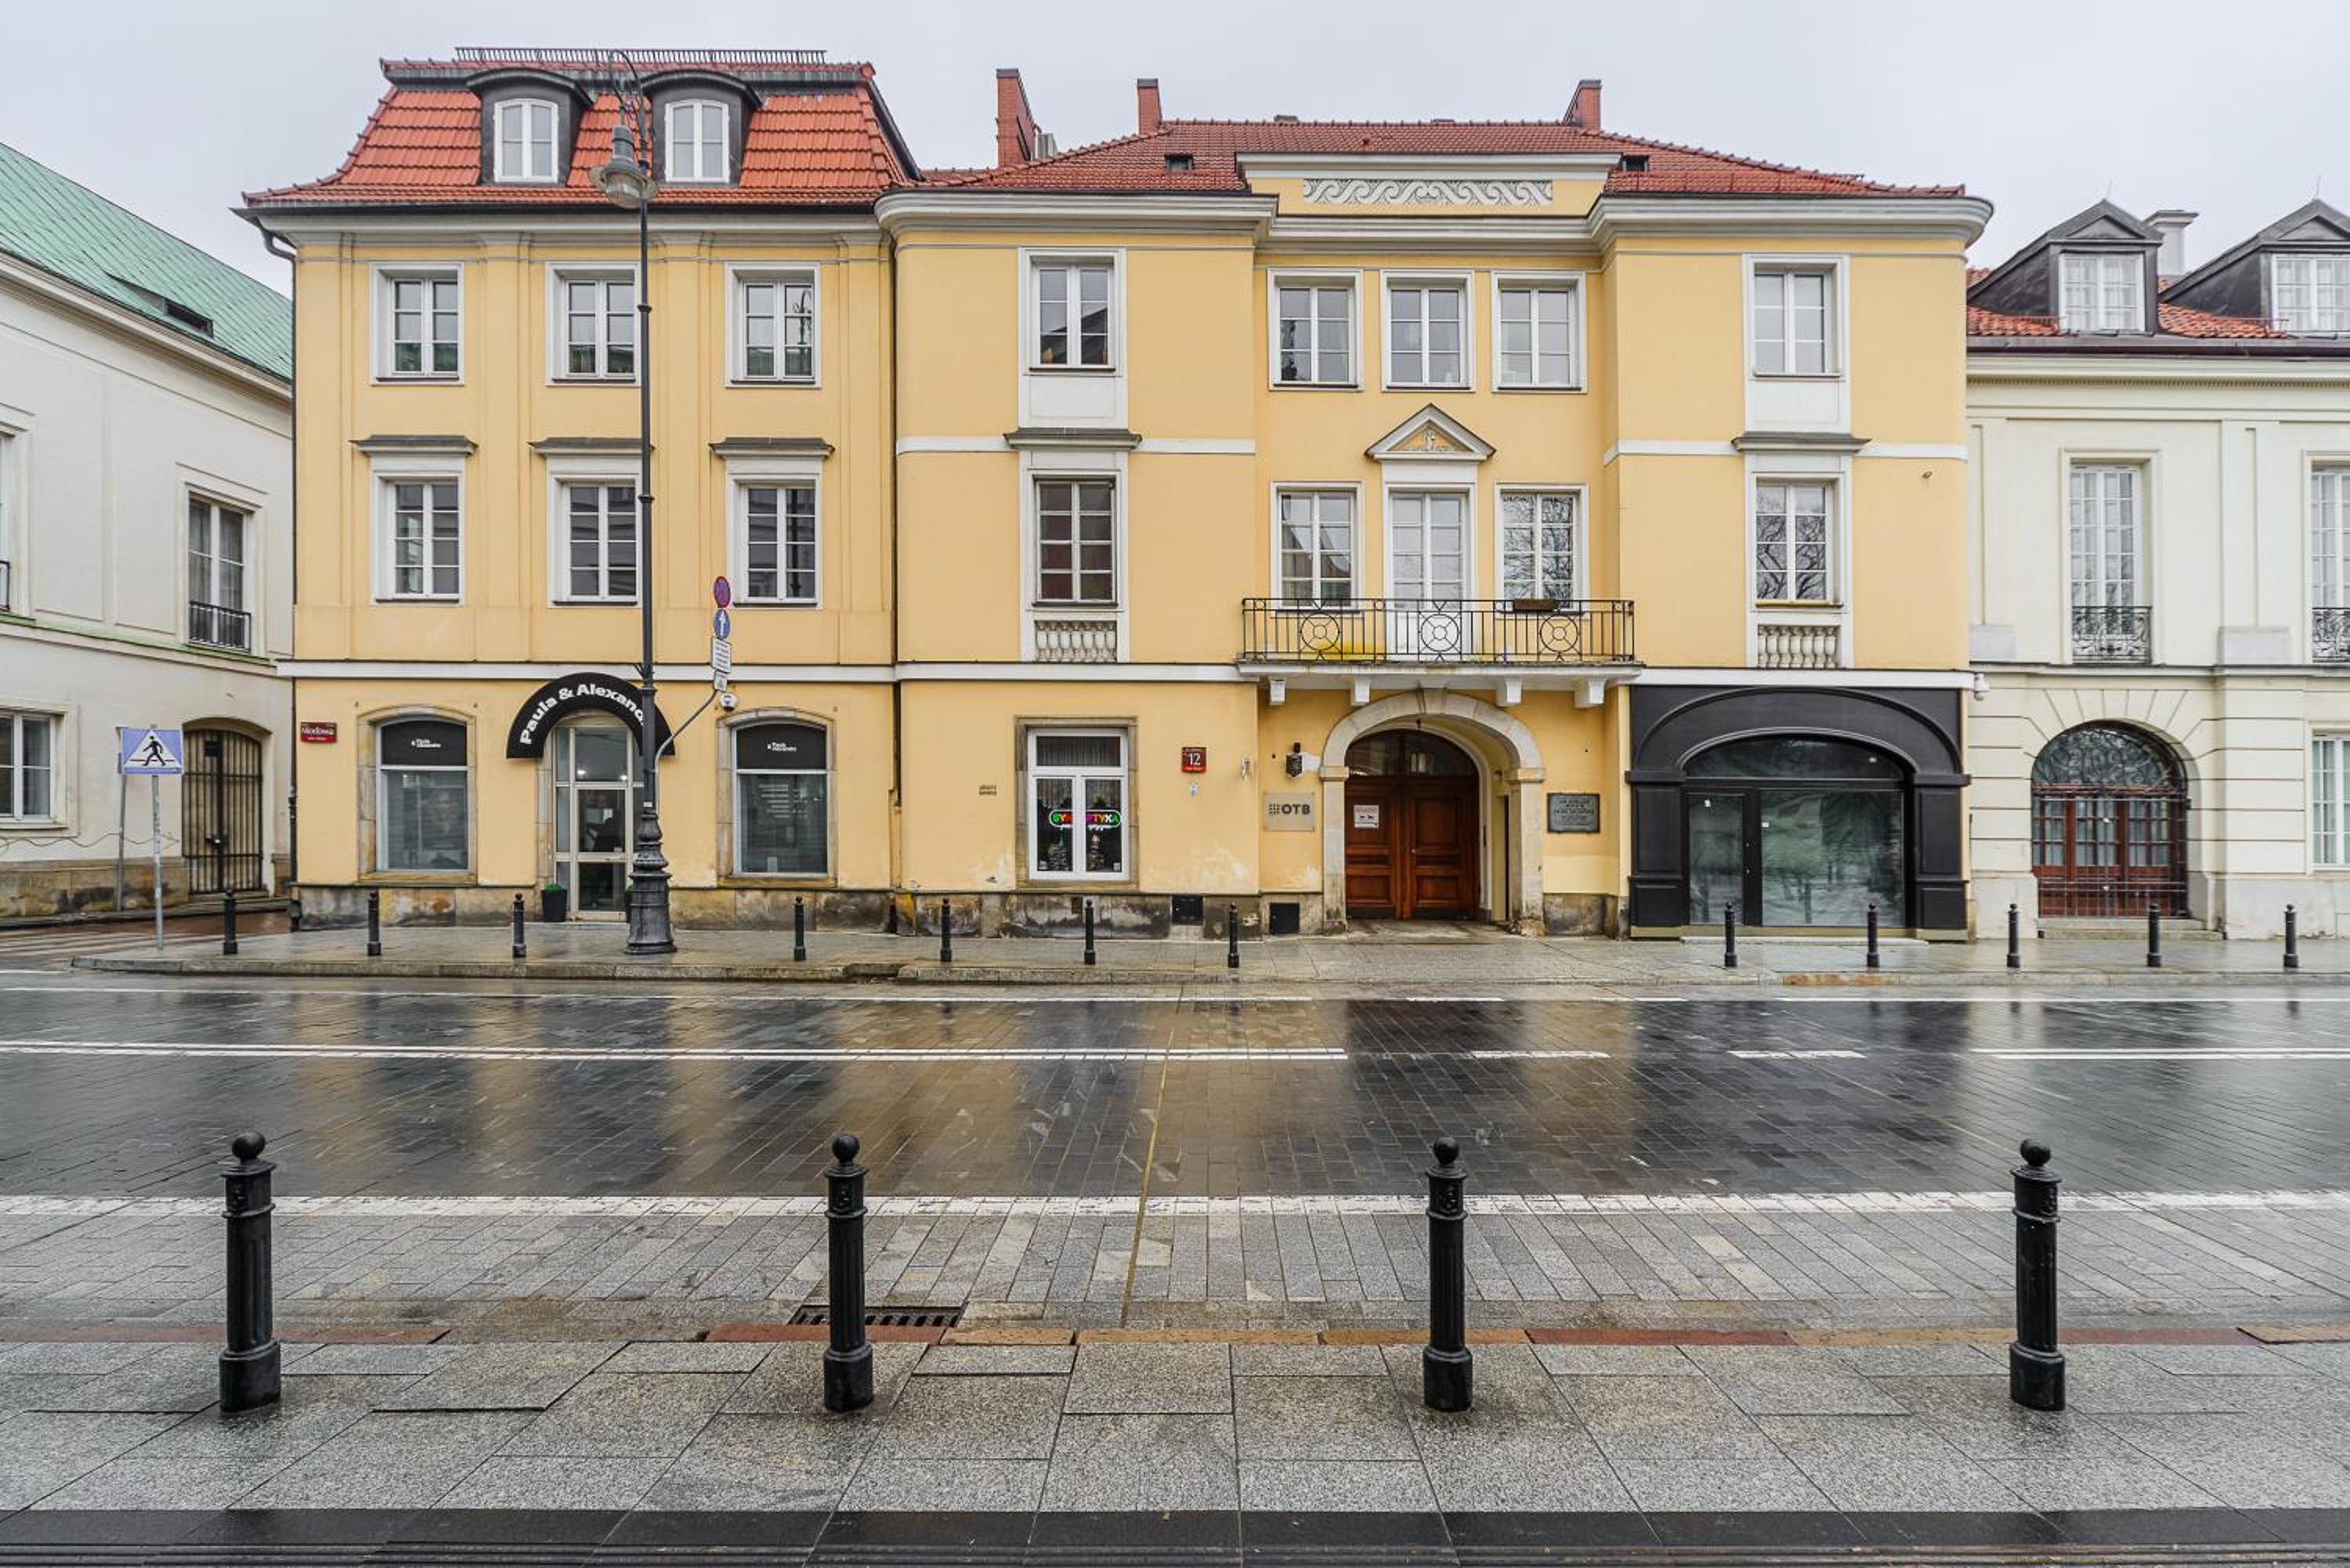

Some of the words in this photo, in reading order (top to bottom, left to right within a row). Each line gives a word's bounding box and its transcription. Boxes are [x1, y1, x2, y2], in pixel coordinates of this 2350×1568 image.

[519, 696, 559, 744] Paula
[559, 687, 576, 701] &
[577, 683, 644, 726] Alexand
[1188, 753, 1201, 765] 12
[1282, 804, 1311, 815] OTB
